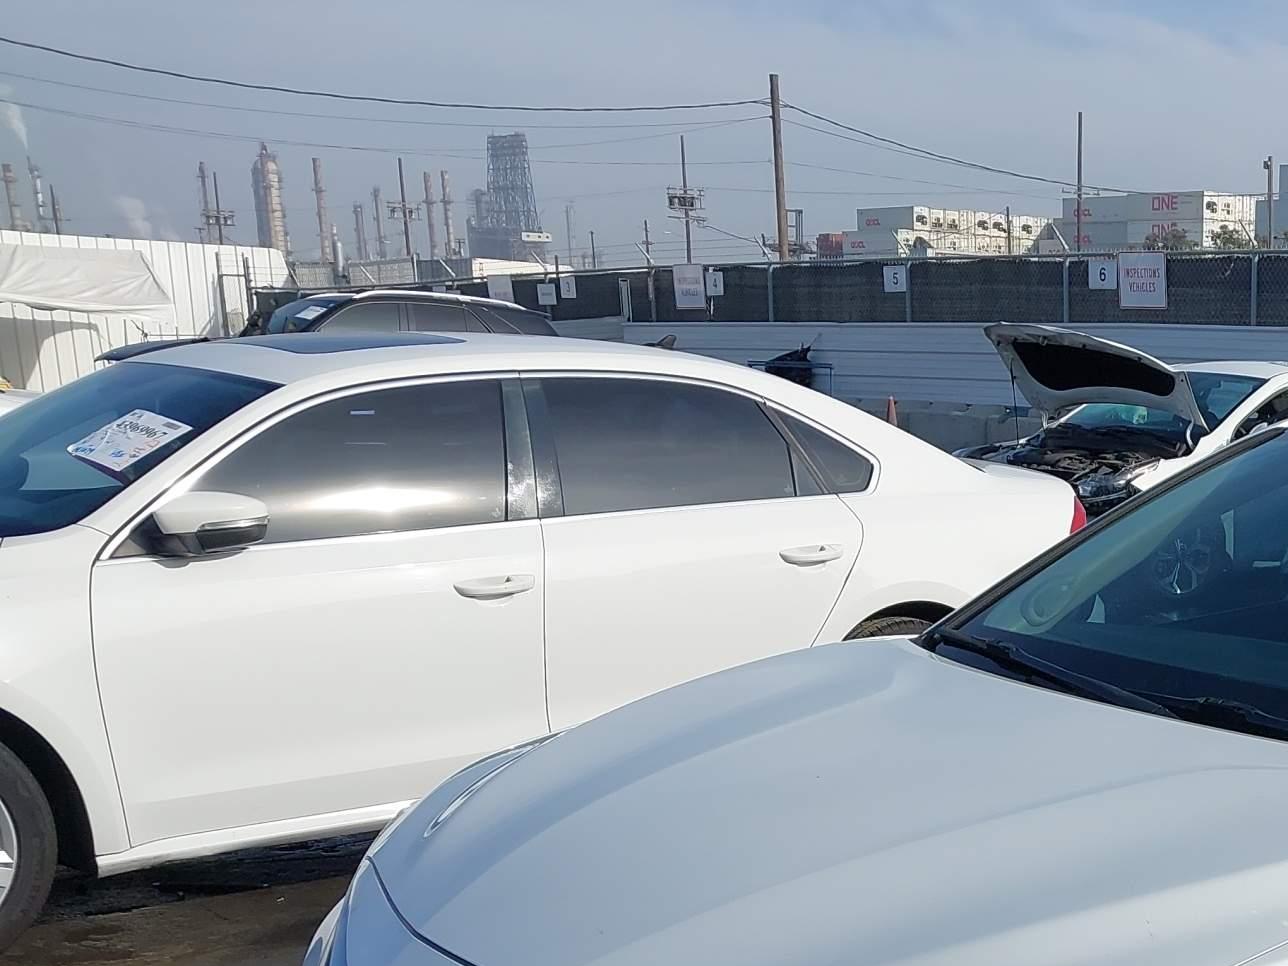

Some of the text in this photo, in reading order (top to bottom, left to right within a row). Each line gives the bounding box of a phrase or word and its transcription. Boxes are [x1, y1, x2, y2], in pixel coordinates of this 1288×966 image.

[1152, 194, 1178, 211] ONE
[892, 271, 899, 286] 5
[1099, 267, 1106, 282] 6
[1123, 267, 1160, 279] INSPECTIONS
[712, 277, 718, 289] 4
[1129, 281, 1156, 293] VEHICLES
